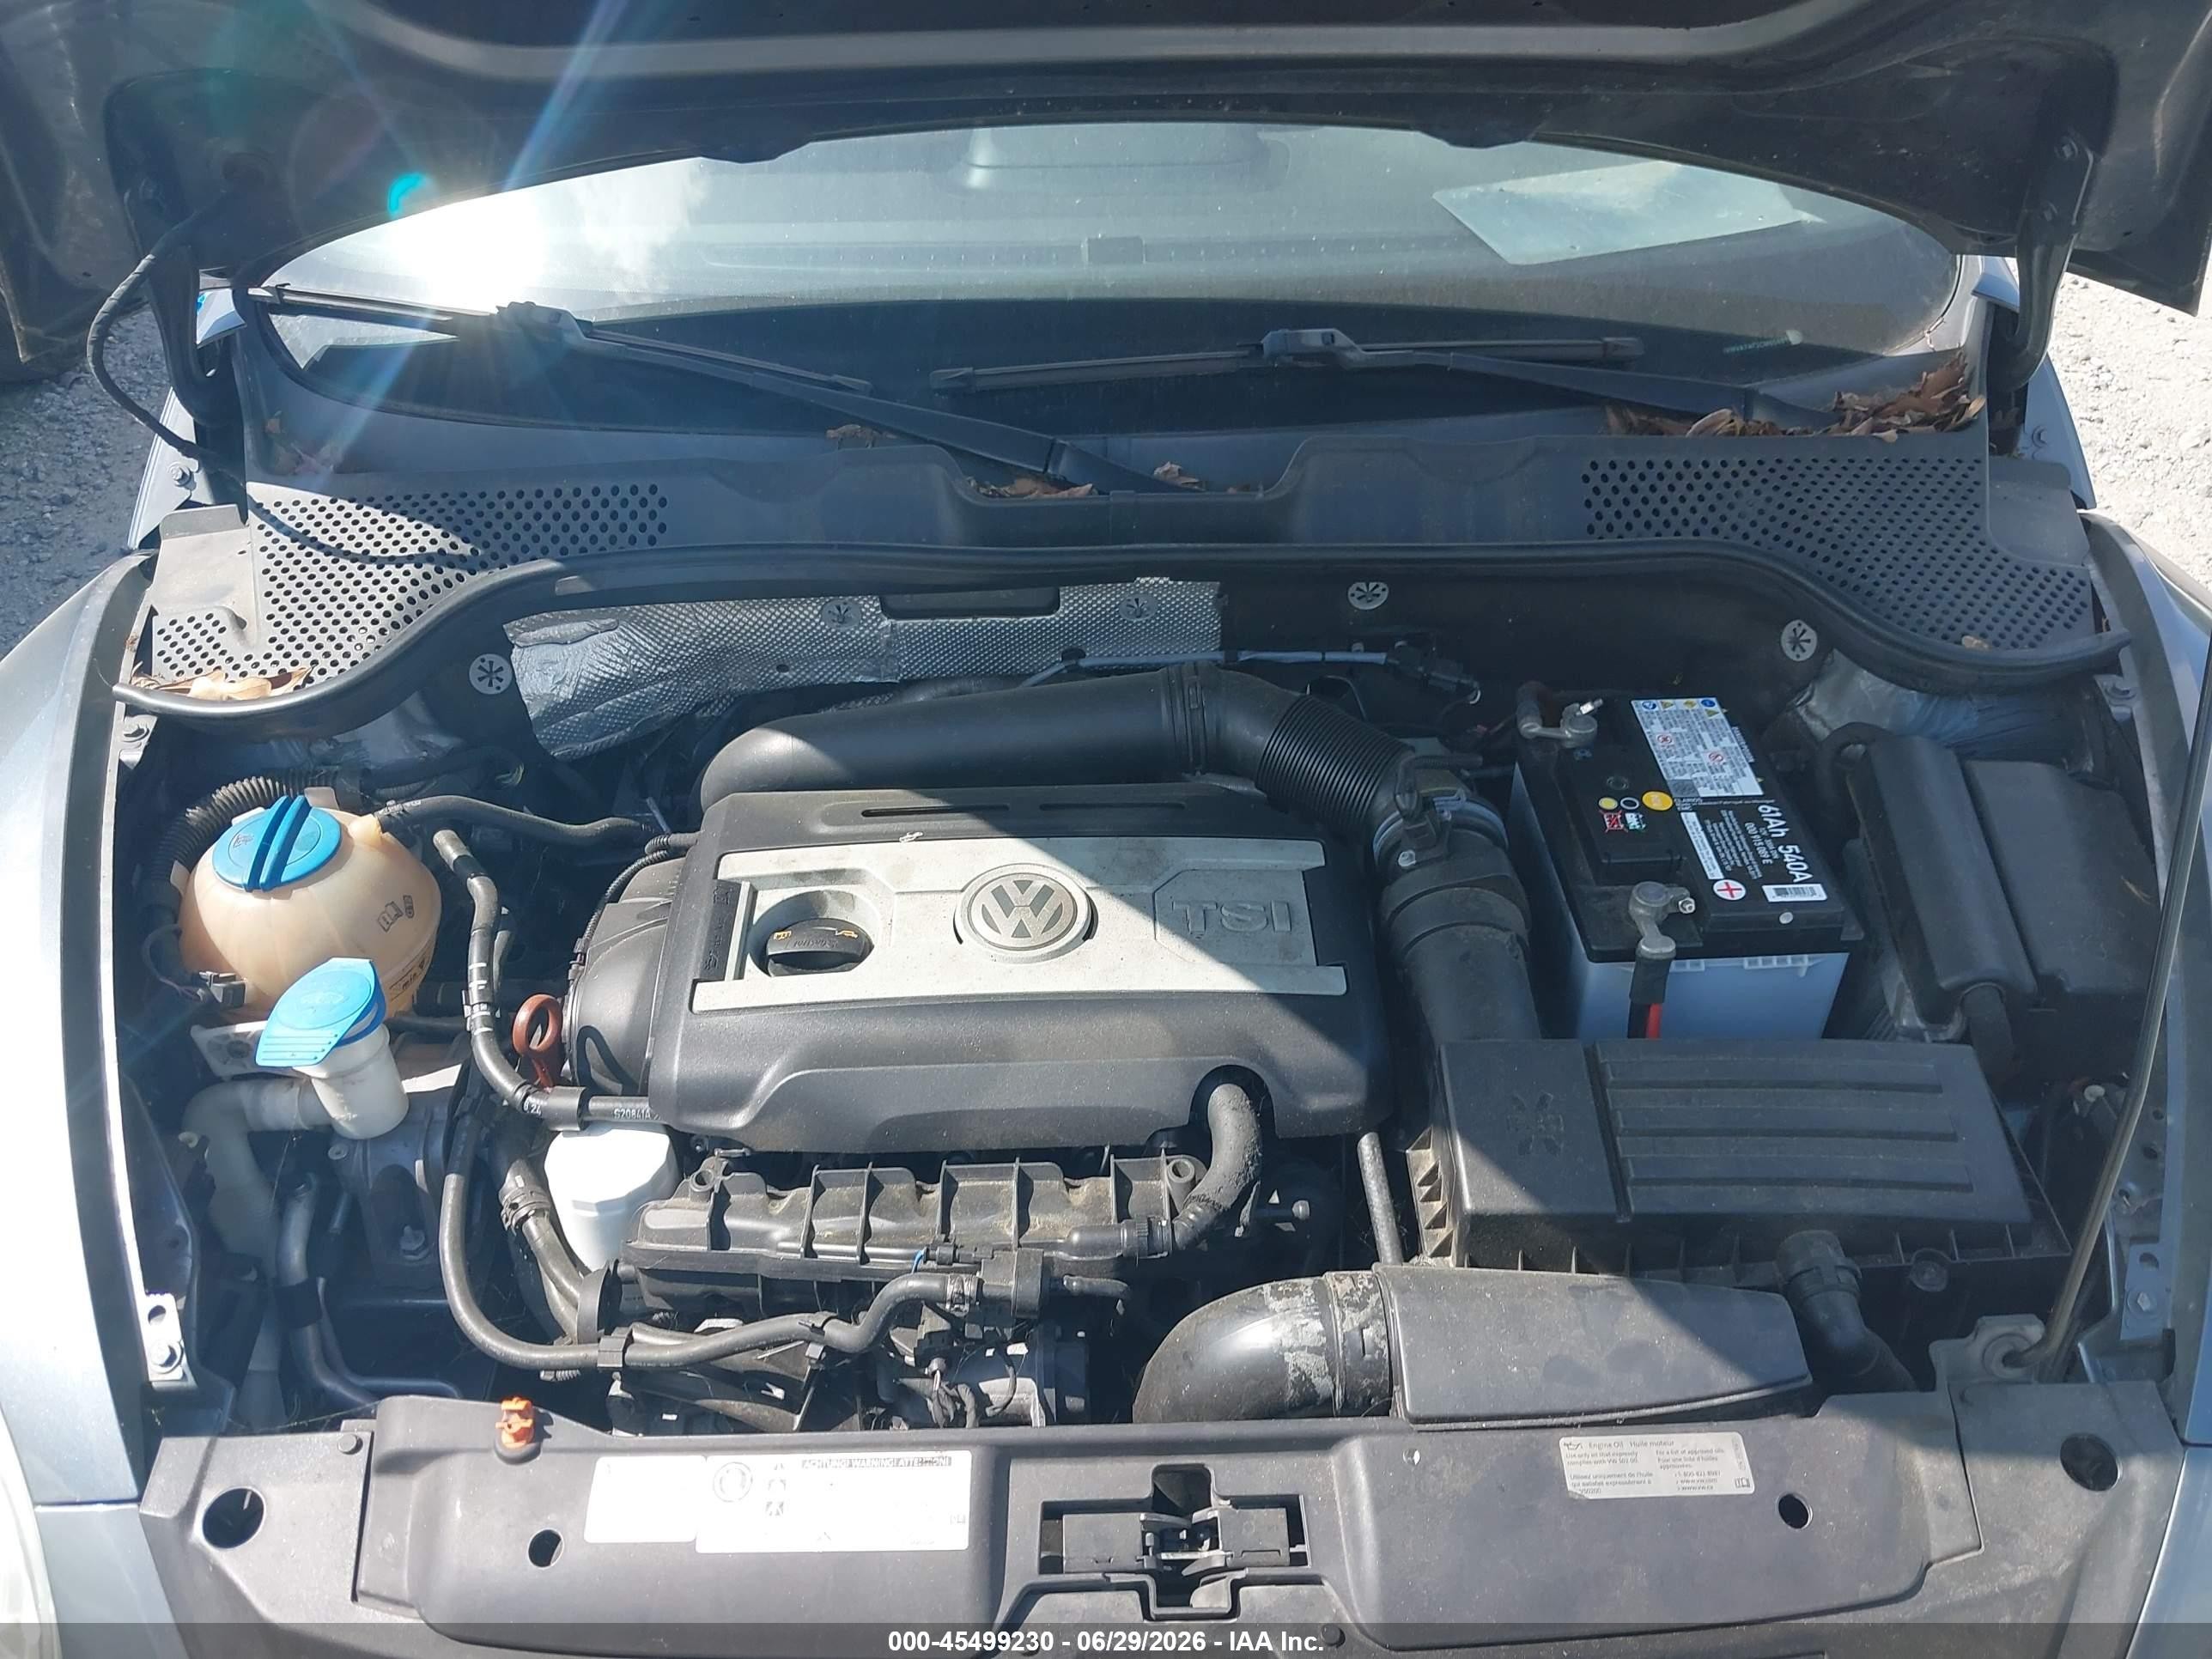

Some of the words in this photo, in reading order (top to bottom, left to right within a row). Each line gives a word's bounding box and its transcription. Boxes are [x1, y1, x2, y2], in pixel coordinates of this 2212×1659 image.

[1758, 805, 1790, 838] 61Ah
[1778, 845, 1814, 883] 540A
[1172, 899, 1291, 933] TSI
[1589, 1442, 1612, 1450] Engine
[1613, 1440, 1624, 1449] Oil
[1630, 1440, 1648, 1449] Huile
[851, 1457, 896, 1468] WARNING!
